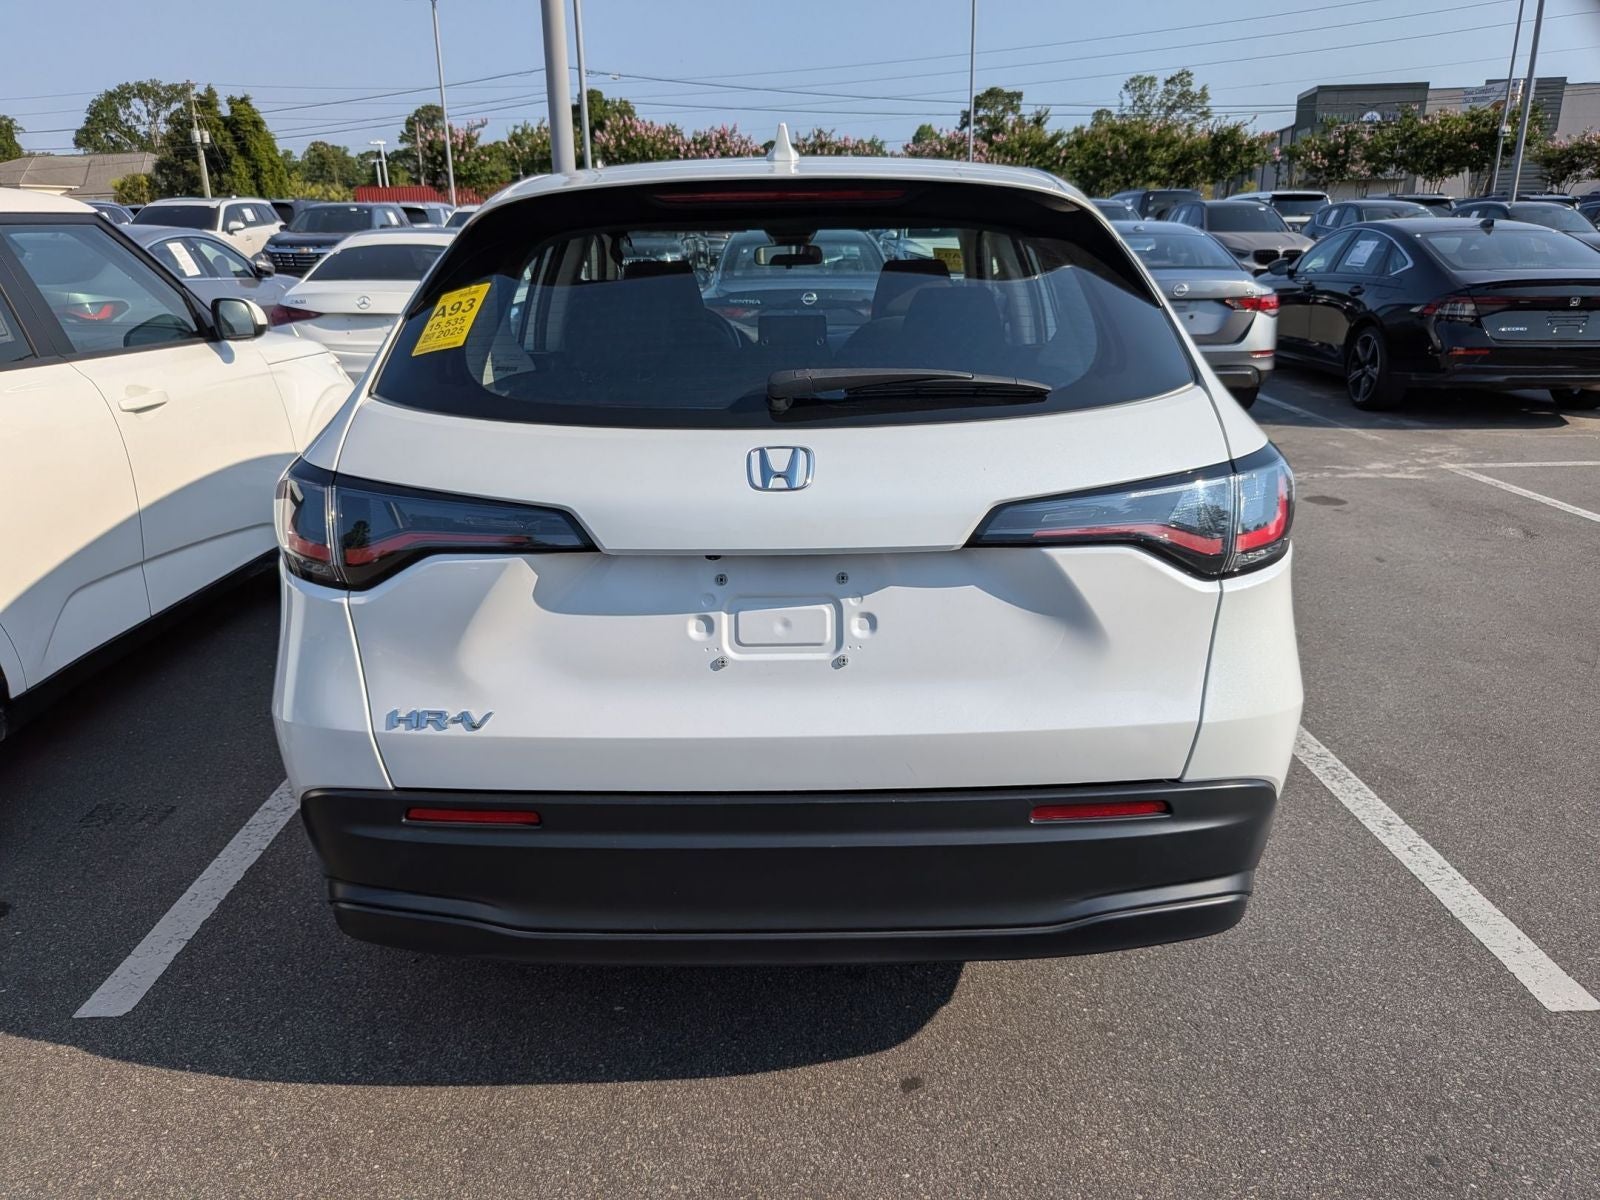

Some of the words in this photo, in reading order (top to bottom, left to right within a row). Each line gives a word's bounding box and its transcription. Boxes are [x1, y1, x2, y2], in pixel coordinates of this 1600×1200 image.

[431, 298, 476, 320] A93
[437, 326, 465, 338] 2025
[385, 709, 494, 732] HR-V
